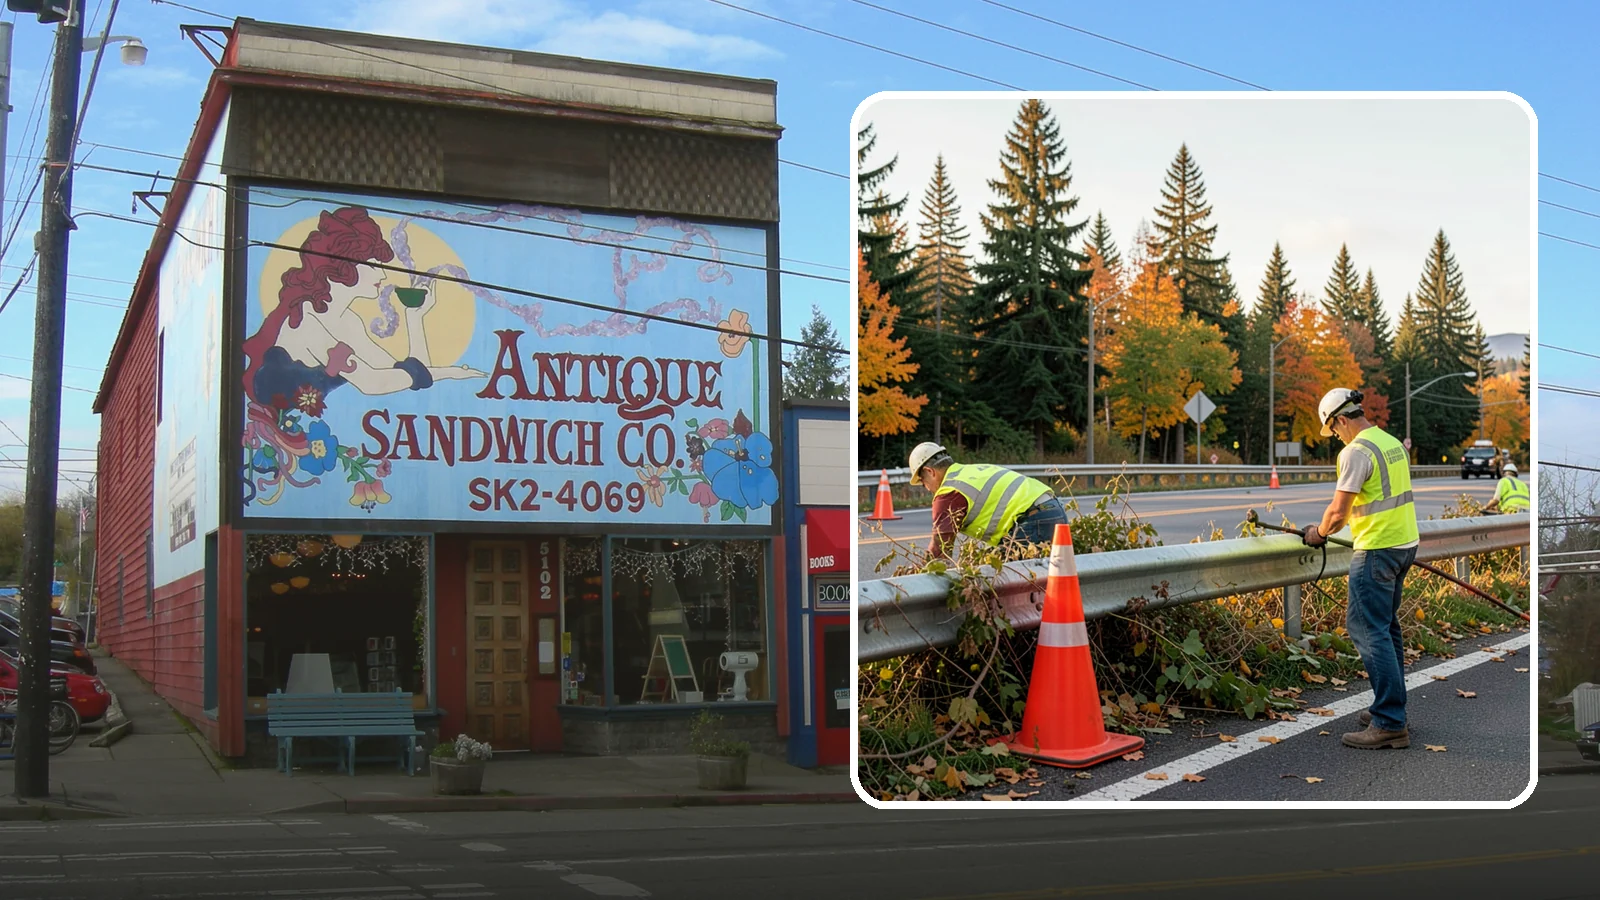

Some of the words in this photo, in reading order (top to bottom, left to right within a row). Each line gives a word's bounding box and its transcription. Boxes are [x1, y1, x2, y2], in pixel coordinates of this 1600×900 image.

[476, 329, 724, 421] ANTIQUE
[361, 408, 604, 467] SANDWICH
[616, 422, 685, 469] CO.
[468, 477, 646, 513] SK2-4069
[539, 541, 552, 600] 5102
[809, 555, 835, 569] BOOKS
